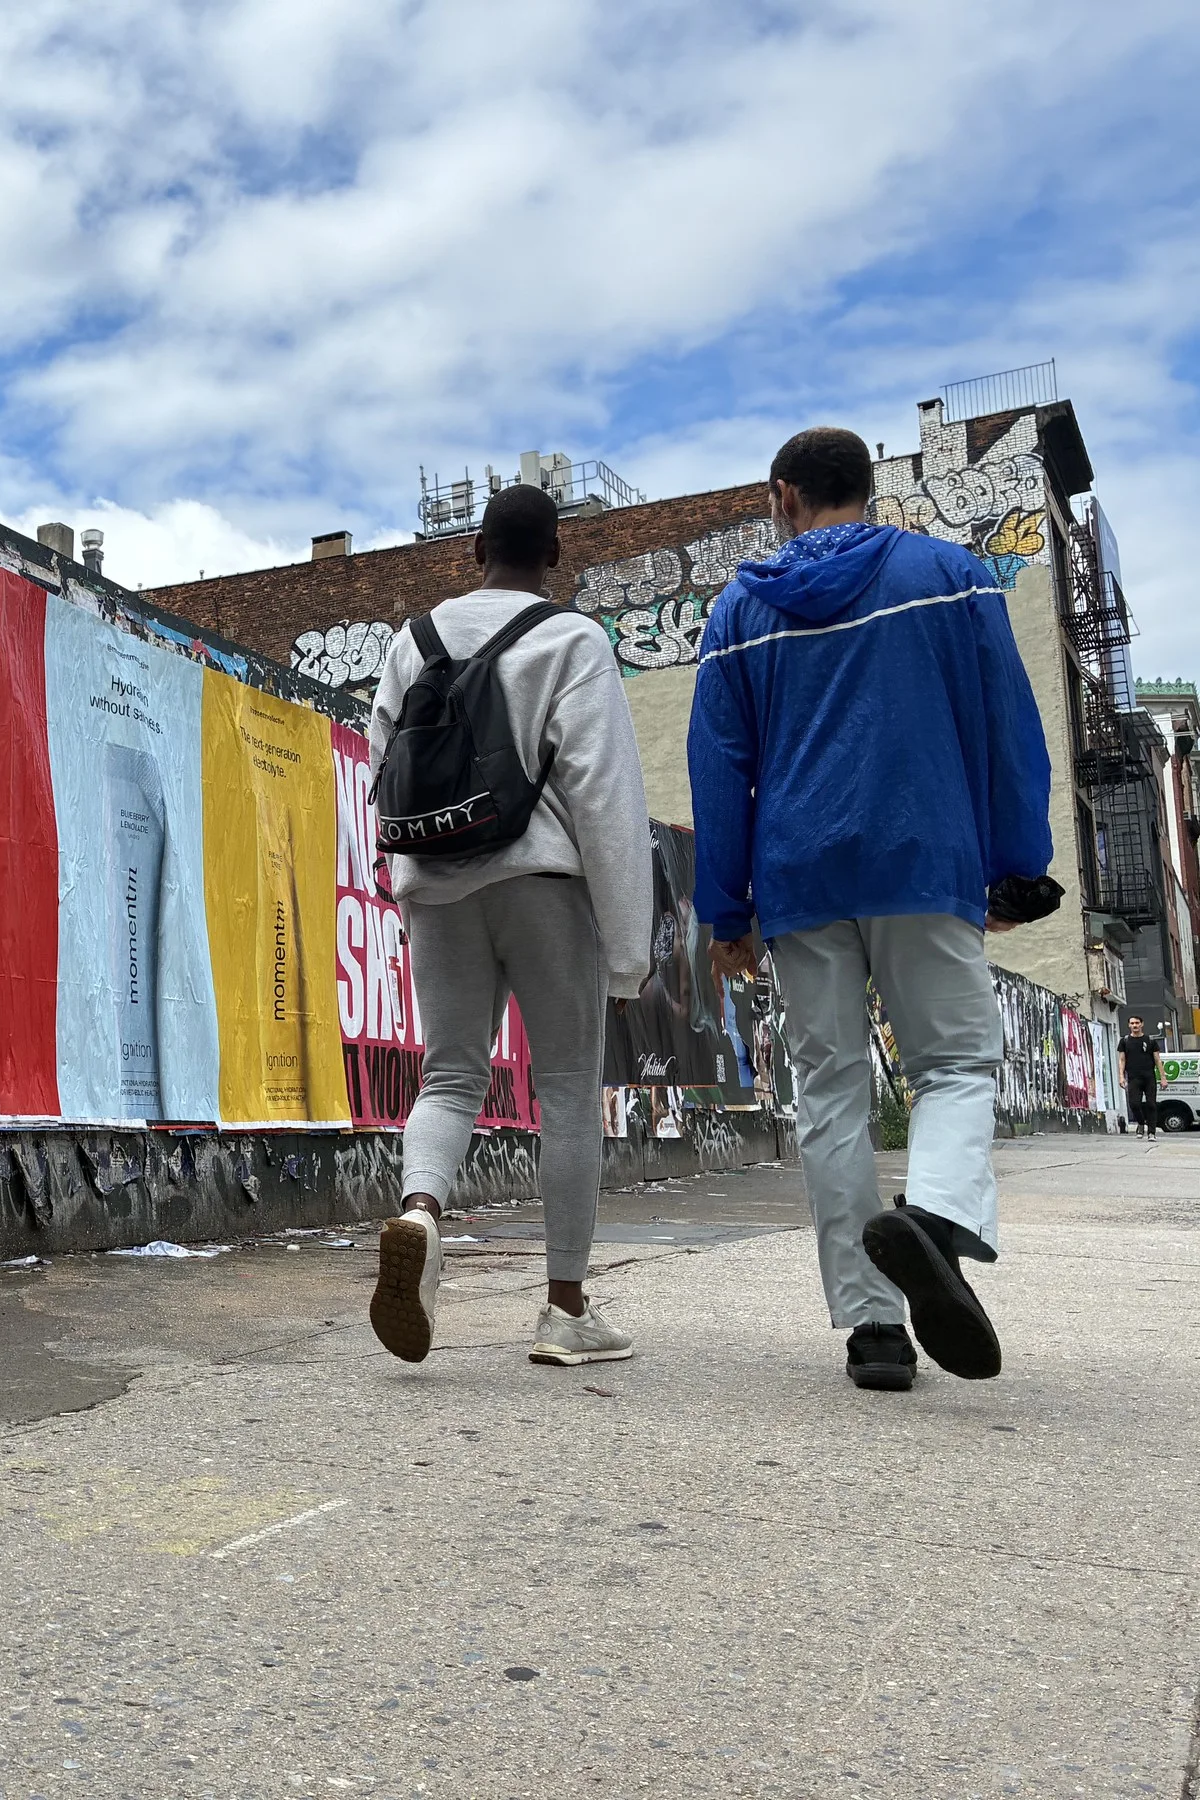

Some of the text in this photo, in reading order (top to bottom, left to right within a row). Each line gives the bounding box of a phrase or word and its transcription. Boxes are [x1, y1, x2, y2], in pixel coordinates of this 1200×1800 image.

[380, 803, 474, 840] TOMMY
[266, 1051, 298, 1071] Ignition
[1180, 1060, 1199, 1071] 95
